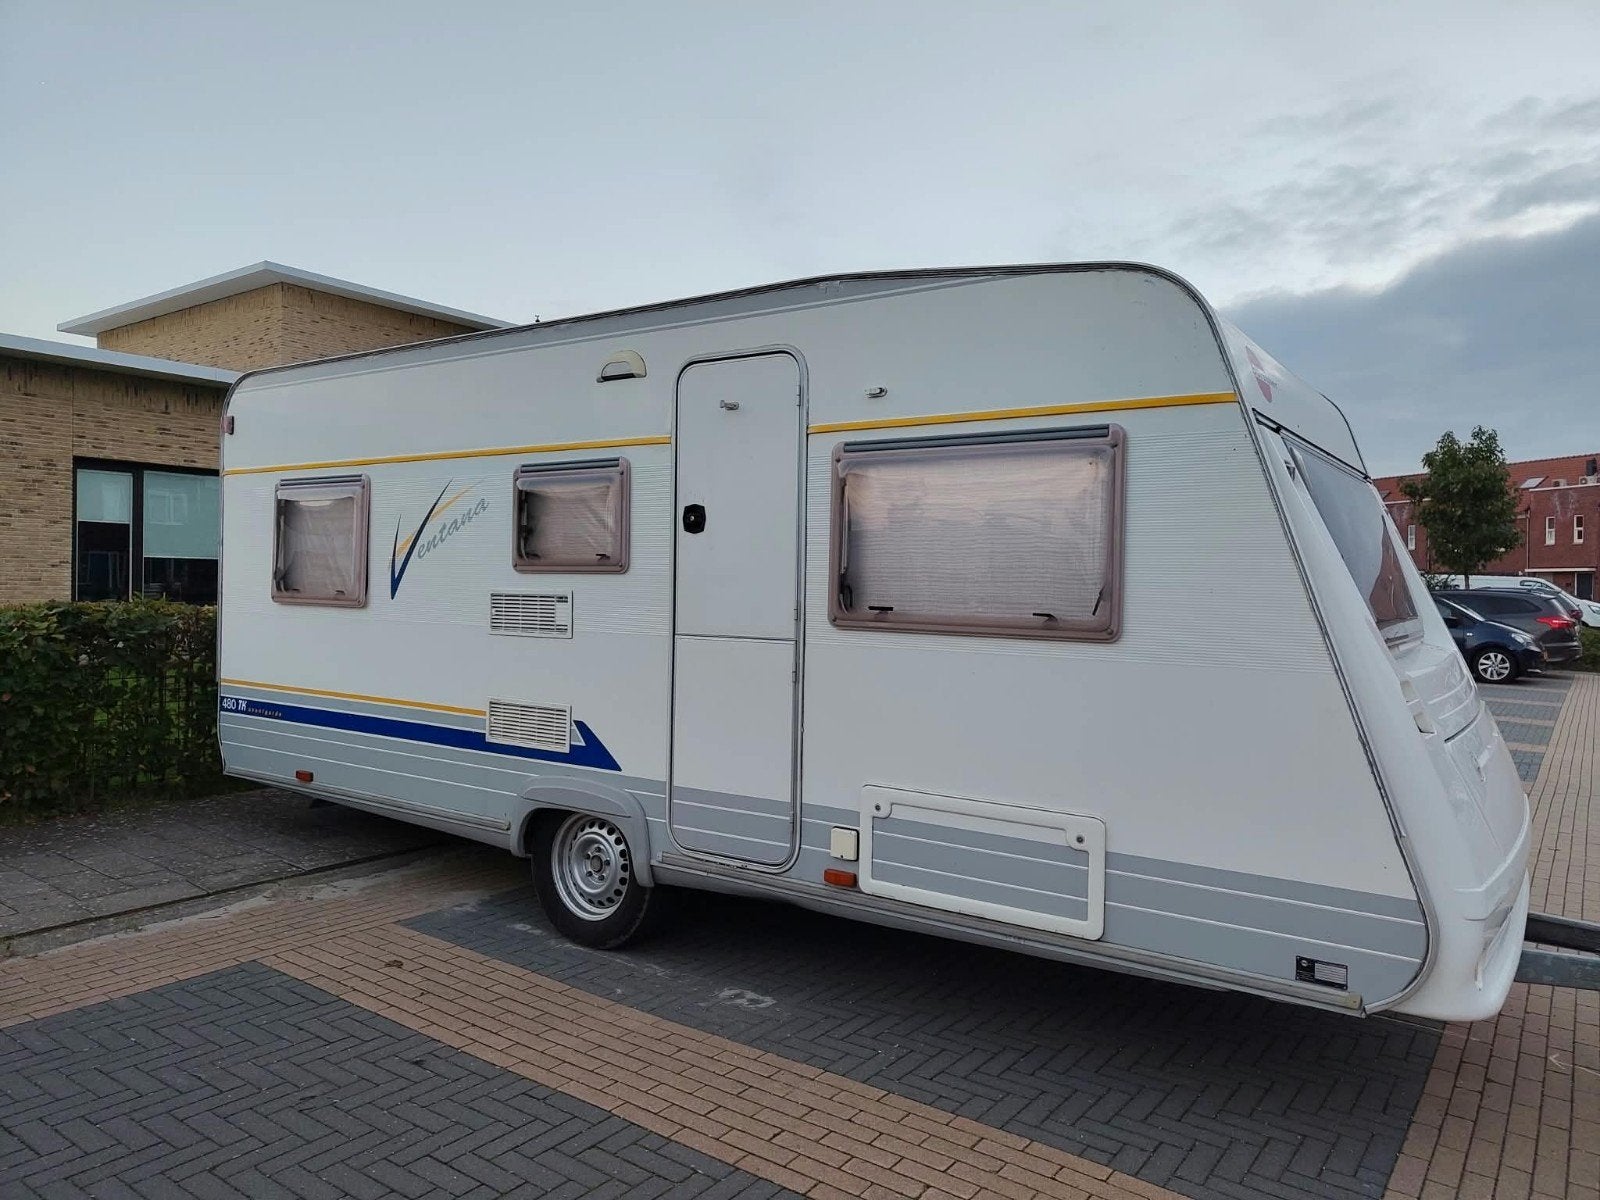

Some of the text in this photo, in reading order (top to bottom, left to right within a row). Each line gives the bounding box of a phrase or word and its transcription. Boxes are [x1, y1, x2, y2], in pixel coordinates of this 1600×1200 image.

[390, 477, 490, 600] Ventana
[222, 698, 237, 710] 480
[238, 699, 248, 712] TK
